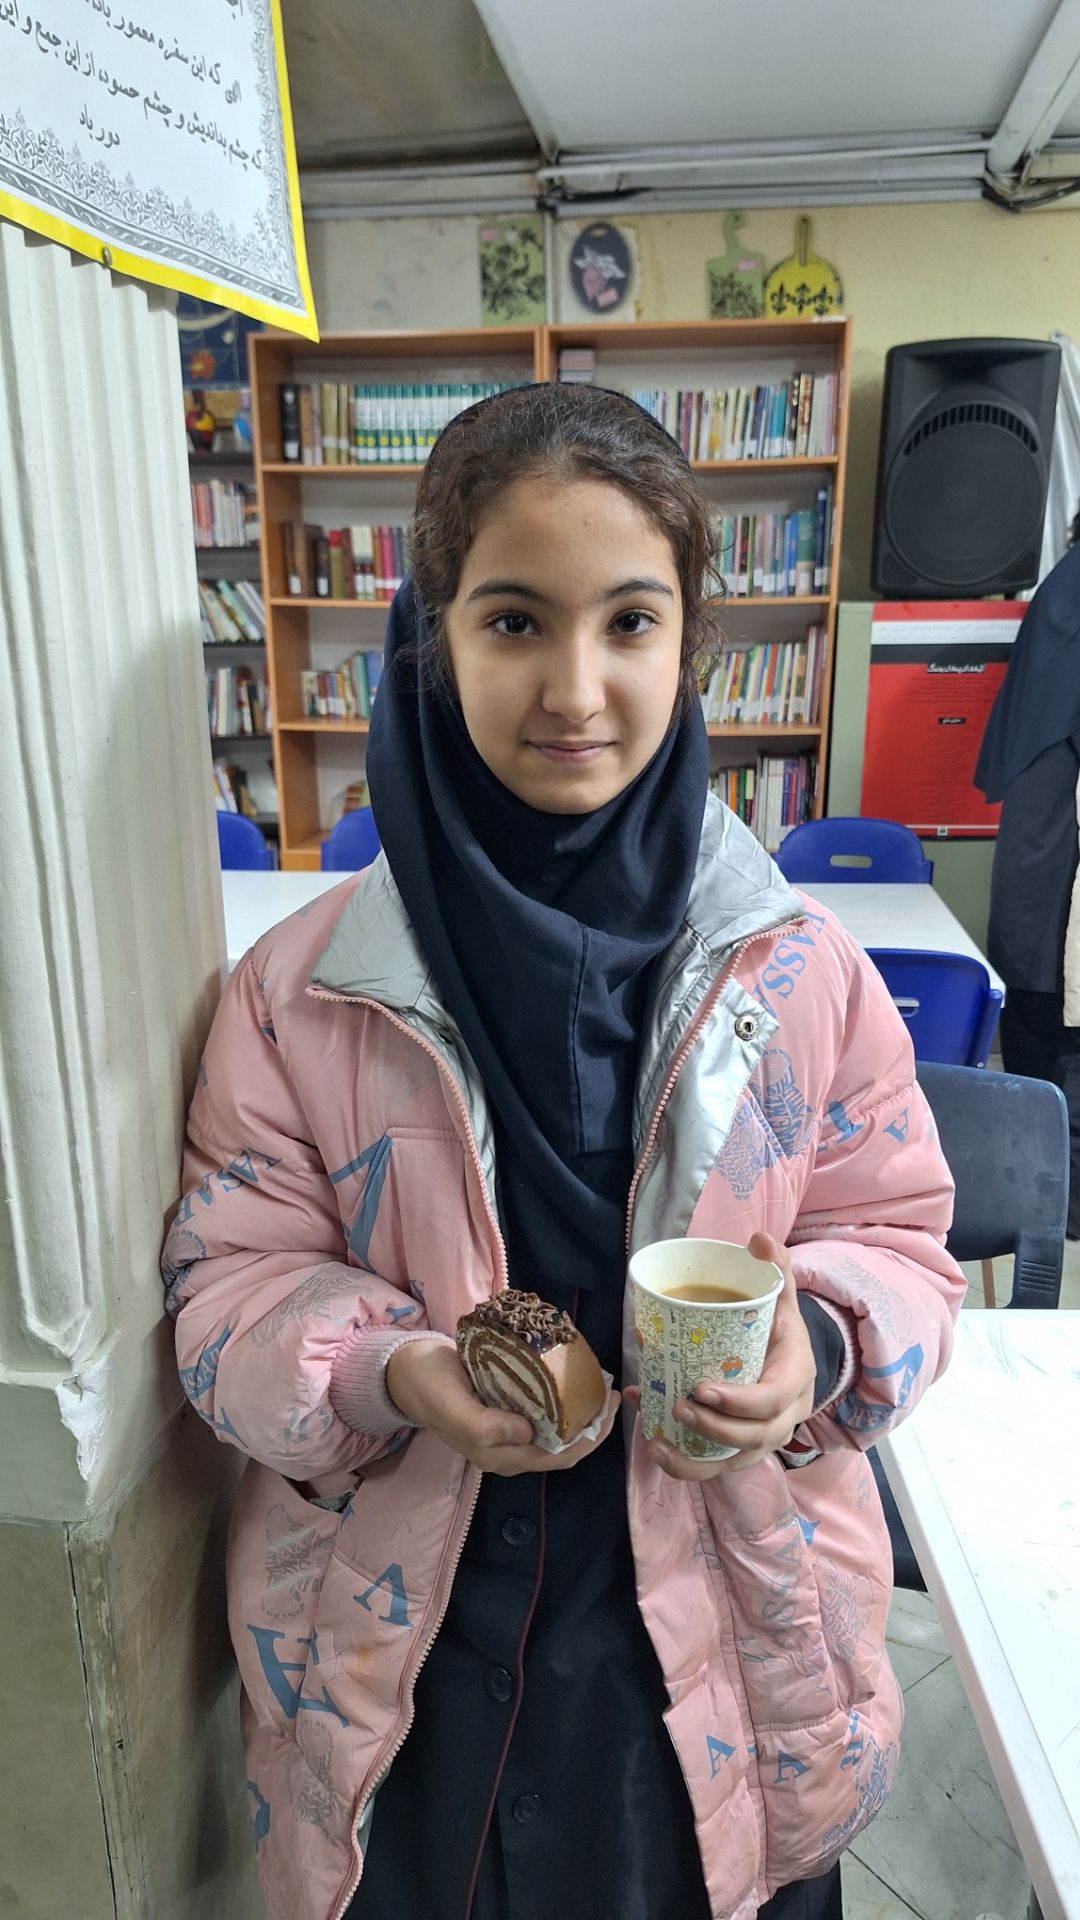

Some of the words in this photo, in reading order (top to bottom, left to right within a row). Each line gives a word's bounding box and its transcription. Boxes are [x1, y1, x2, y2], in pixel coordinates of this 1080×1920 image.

[20, 15, 33, 36] و
[35, 20, 62, 59] جمع
[113, 15, 155, 44] معمور
[64, 39, 81, 72] این
[82, 51, 96, 77] از
[158, 37, 189, 65] سفره
[190, 54, 207, 82] این
[79, 103, 94, 141] باد
[143, 90, 173, 129] چشم
[174, 112, 185, 130] و
[94, 127, 121, 149] دور
[228, 137, 250, 172] چشم
